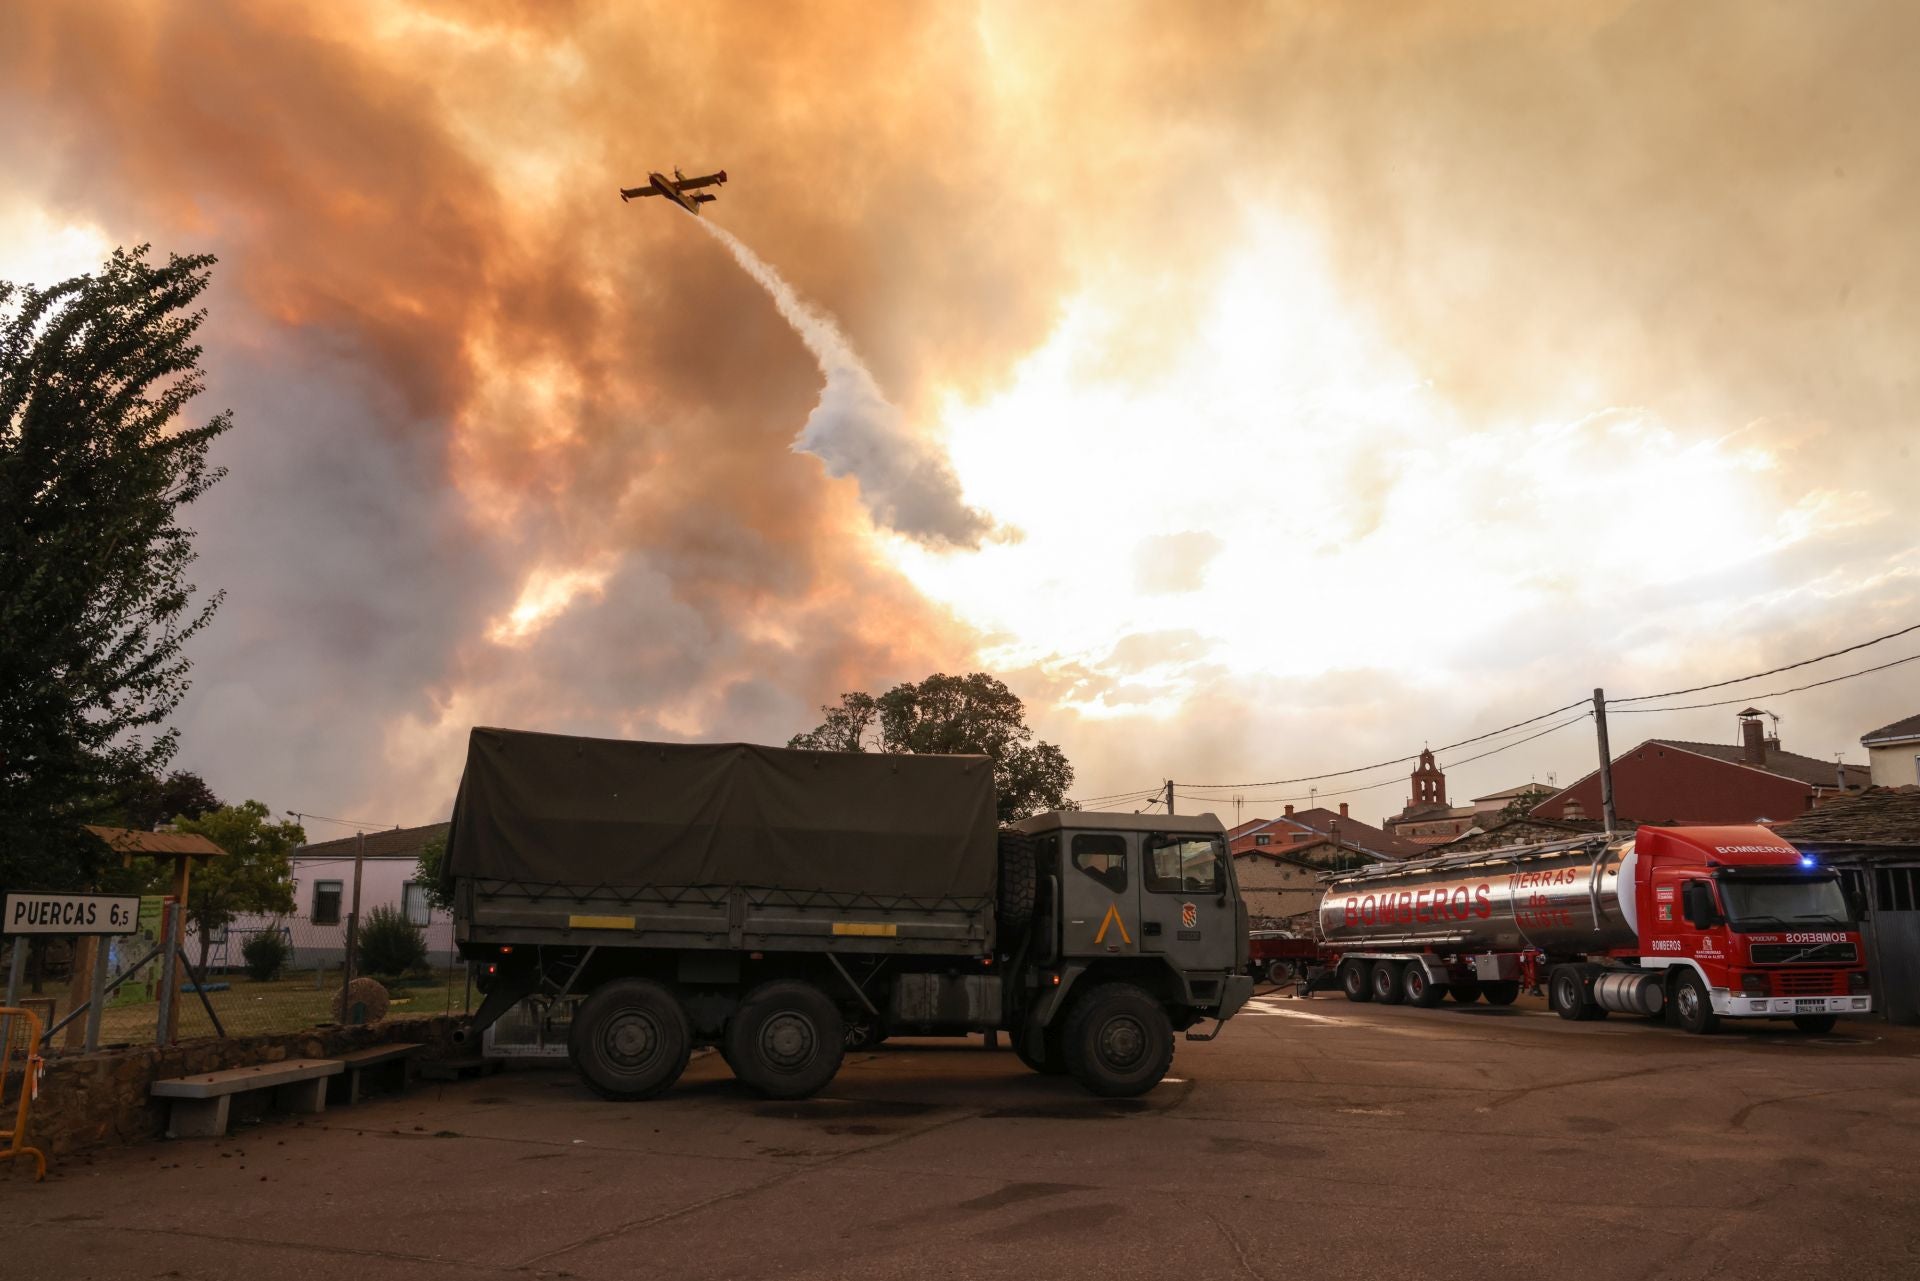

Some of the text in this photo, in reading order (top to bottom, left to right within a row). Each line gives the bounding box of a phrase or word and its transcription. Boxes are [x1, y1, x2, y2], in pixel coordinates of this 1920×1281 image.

[1714, 845, 1796, 854] BOMBEROS
[1508, 868, 1576, 890] TIERRAS
[1344, 883, 1492, 928] BOMBEROS
[1529, 891, 1547, 908] de
[14, 901, 129, 927] PUERCAS 6,5
[1516, 909, 1575, 928] ALISTE
[1651, 939, 1682, 951] BOMBEROS
